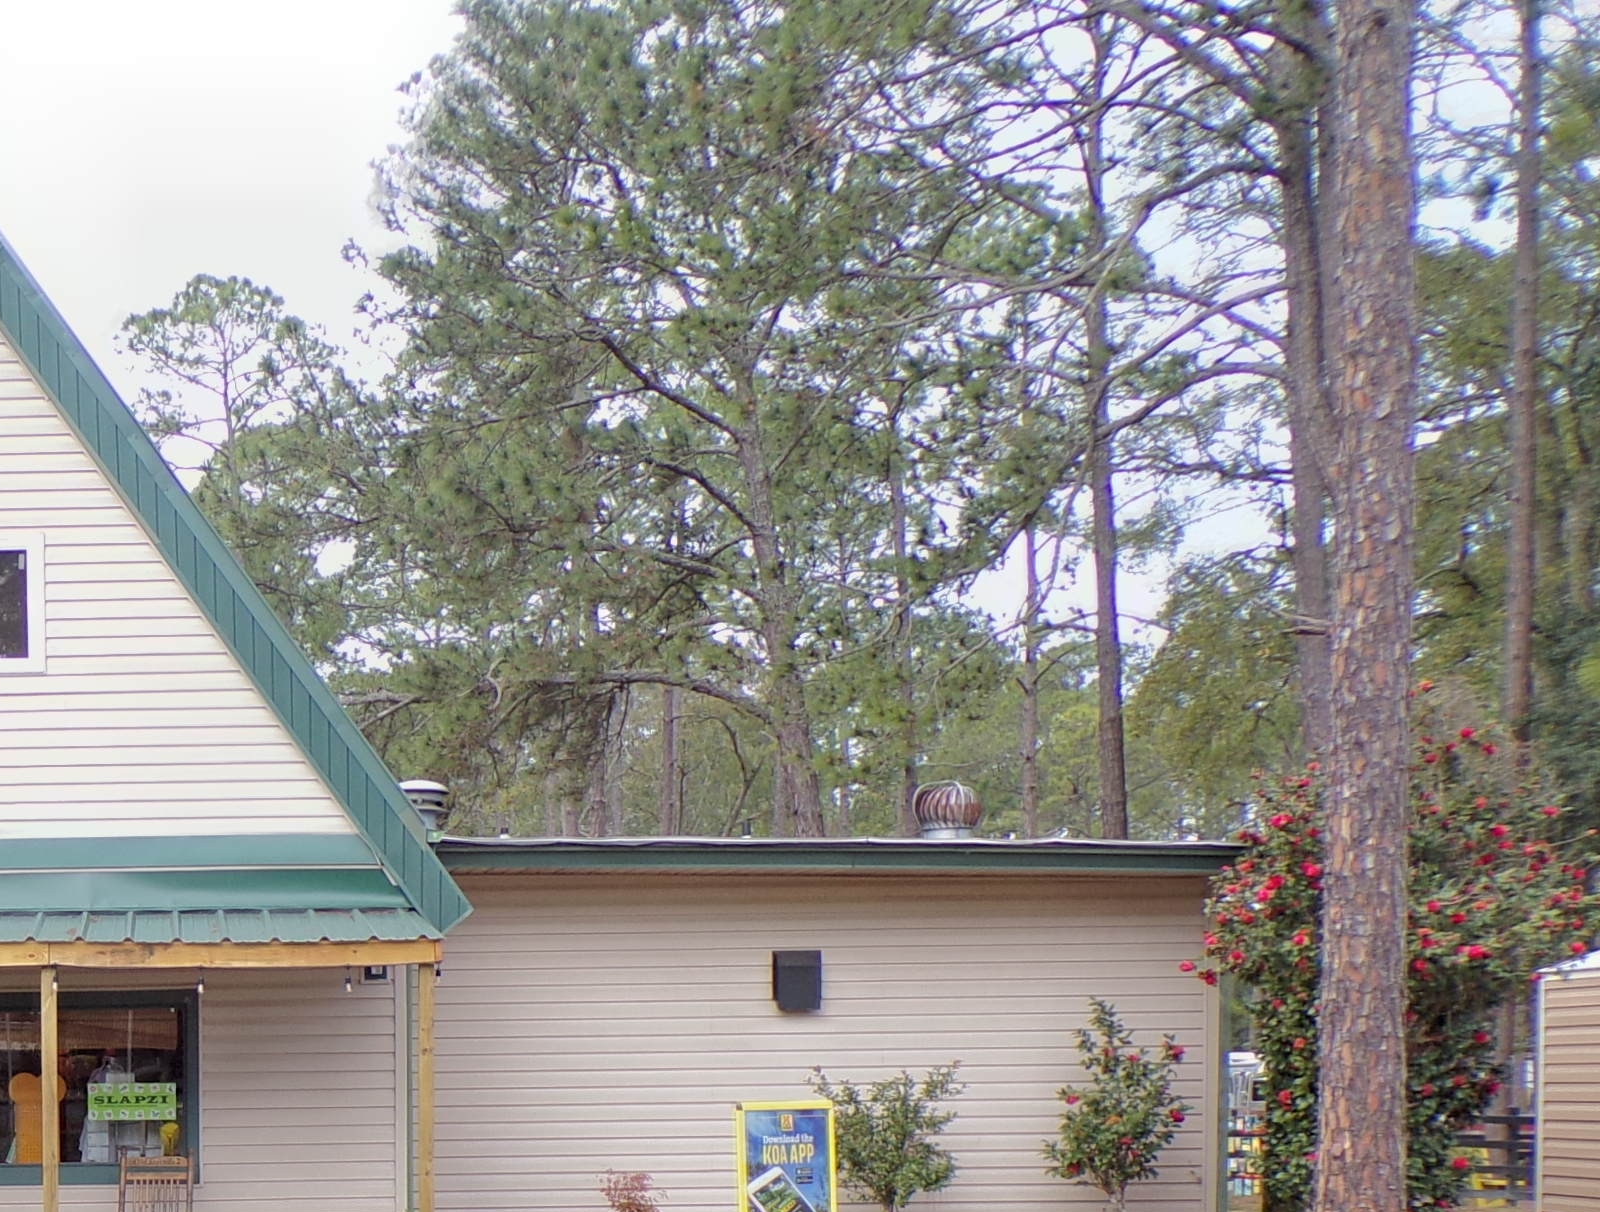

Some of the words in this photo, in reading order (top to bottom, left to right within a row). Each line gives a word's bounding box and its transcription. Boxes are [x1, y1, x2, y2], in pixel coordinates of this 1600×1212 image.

[93, 1095, 169, 1104] SLAPZI
[763, 1132, 800, 1144] Download
[800, 1132, 814, 1143] the
[763, 1144, 789, 1166] KOA
[790, 1143, 815, 1164] APP
